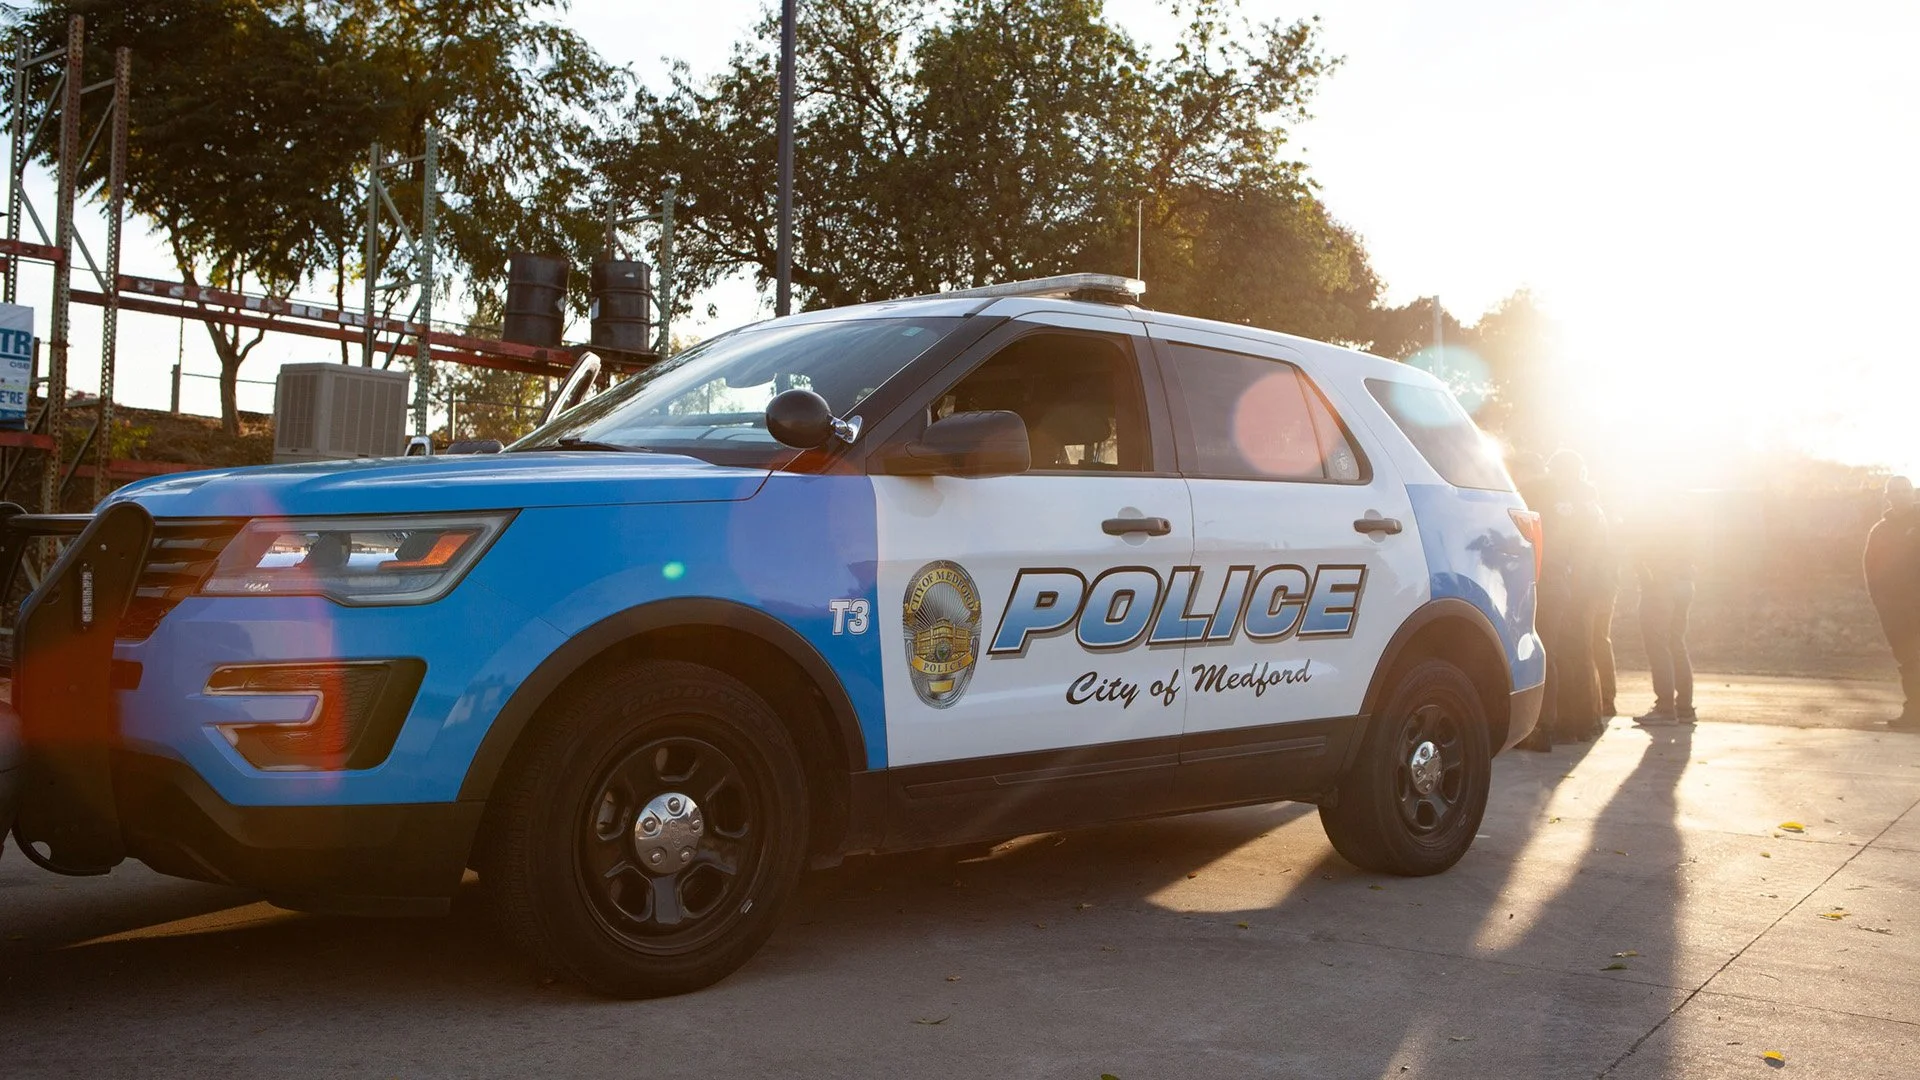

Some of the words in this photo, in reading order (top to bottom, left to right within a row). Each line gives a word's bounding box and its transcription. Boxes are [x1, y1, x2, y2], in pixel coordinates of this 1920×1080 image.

[911, 584, 925, 612] CITY
[922, 574, 934, 588] OF
[936, 571, 975, 610] MEDFORD
[986, 563, 1368, 657] POLICE
[829, 598, 870, 635] T3
[923, 659, 963, 673] POLICE
[1065, 671, 1141, 709] City
[1150, 669, 1181, 707] of
[1192, 659, 1312, 698] Medford
